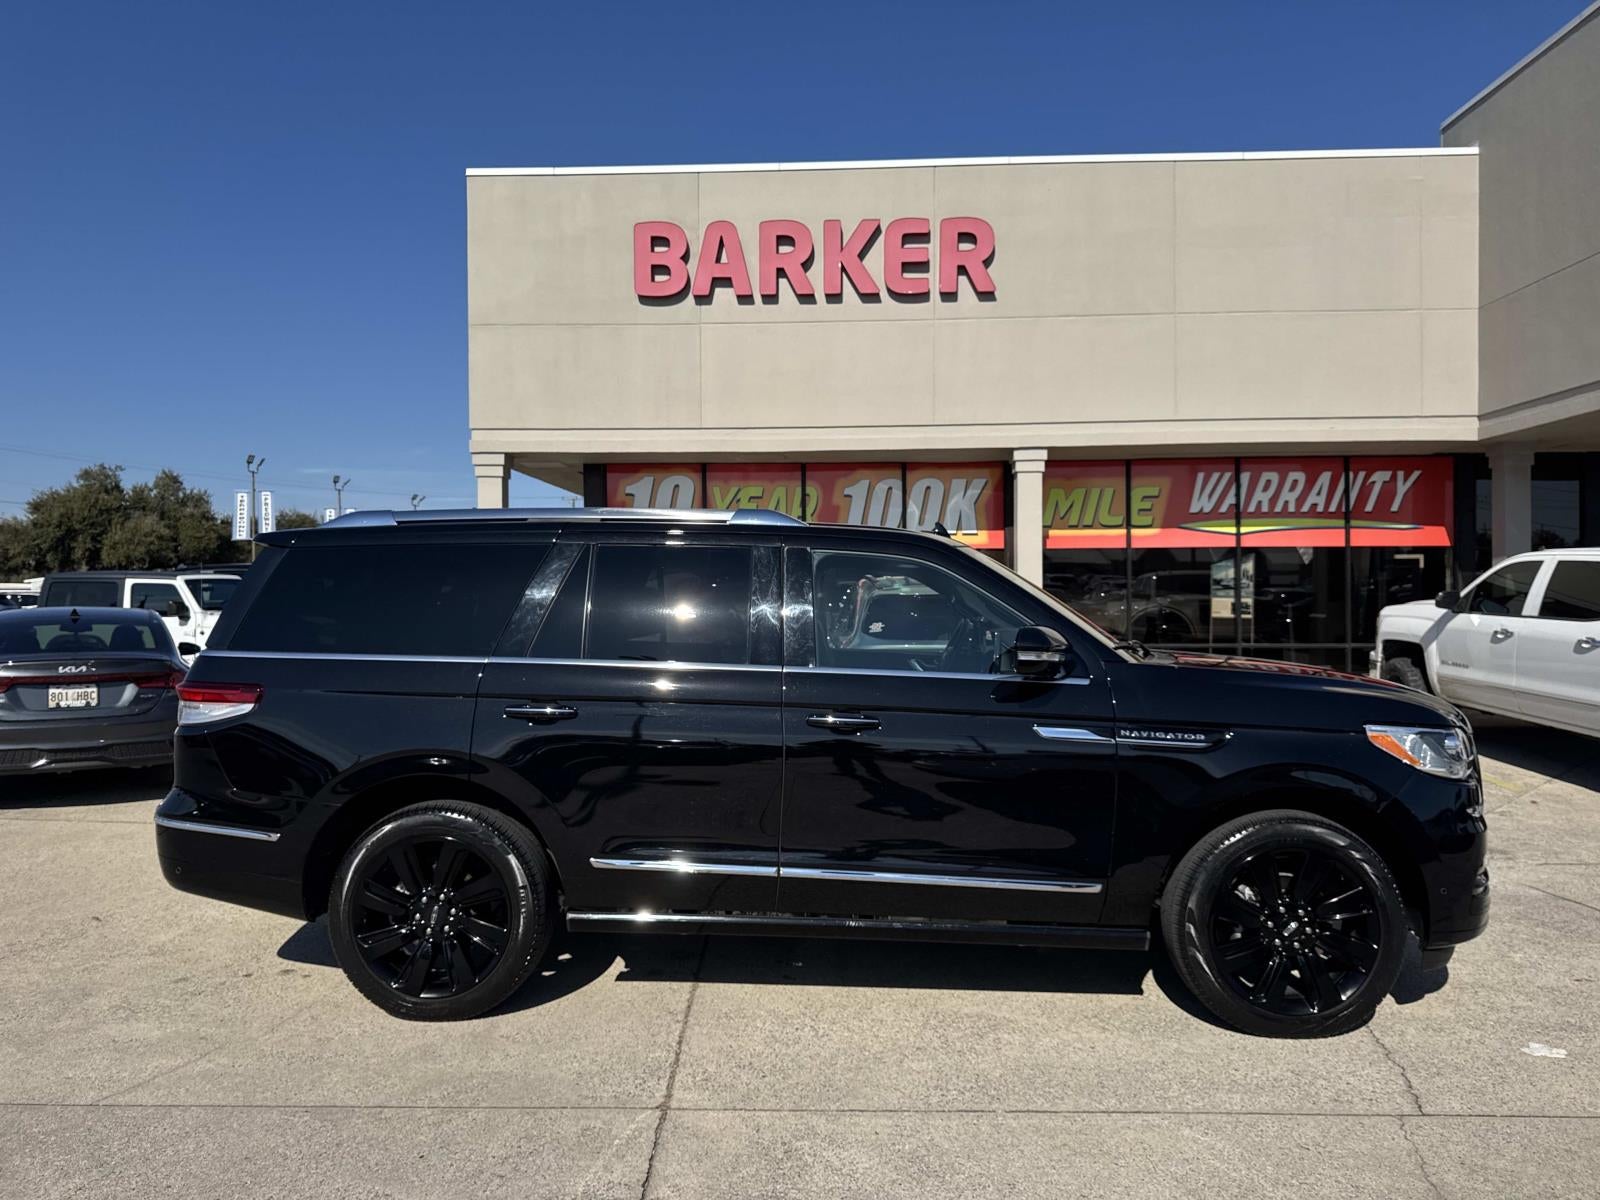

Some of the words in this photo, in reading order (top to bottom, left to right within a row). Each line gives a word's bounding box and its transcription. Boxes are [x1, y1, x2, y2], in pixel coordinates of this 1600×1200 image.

[634, 217, 996, 305] BARKER
[625, 475, 695, 509] 10
[713, 486, 819, 523] YEAR
[844, 478, 988, 535] 100K
[1043, 487, 1161, 528] MILE
[1189, 470, 1422, 514] WARRANTY
[50, 692, 69, 702] 801
[76, 690, 96, 701] HBC
[1120, 729, 1206, 740] NAVIGATOR
